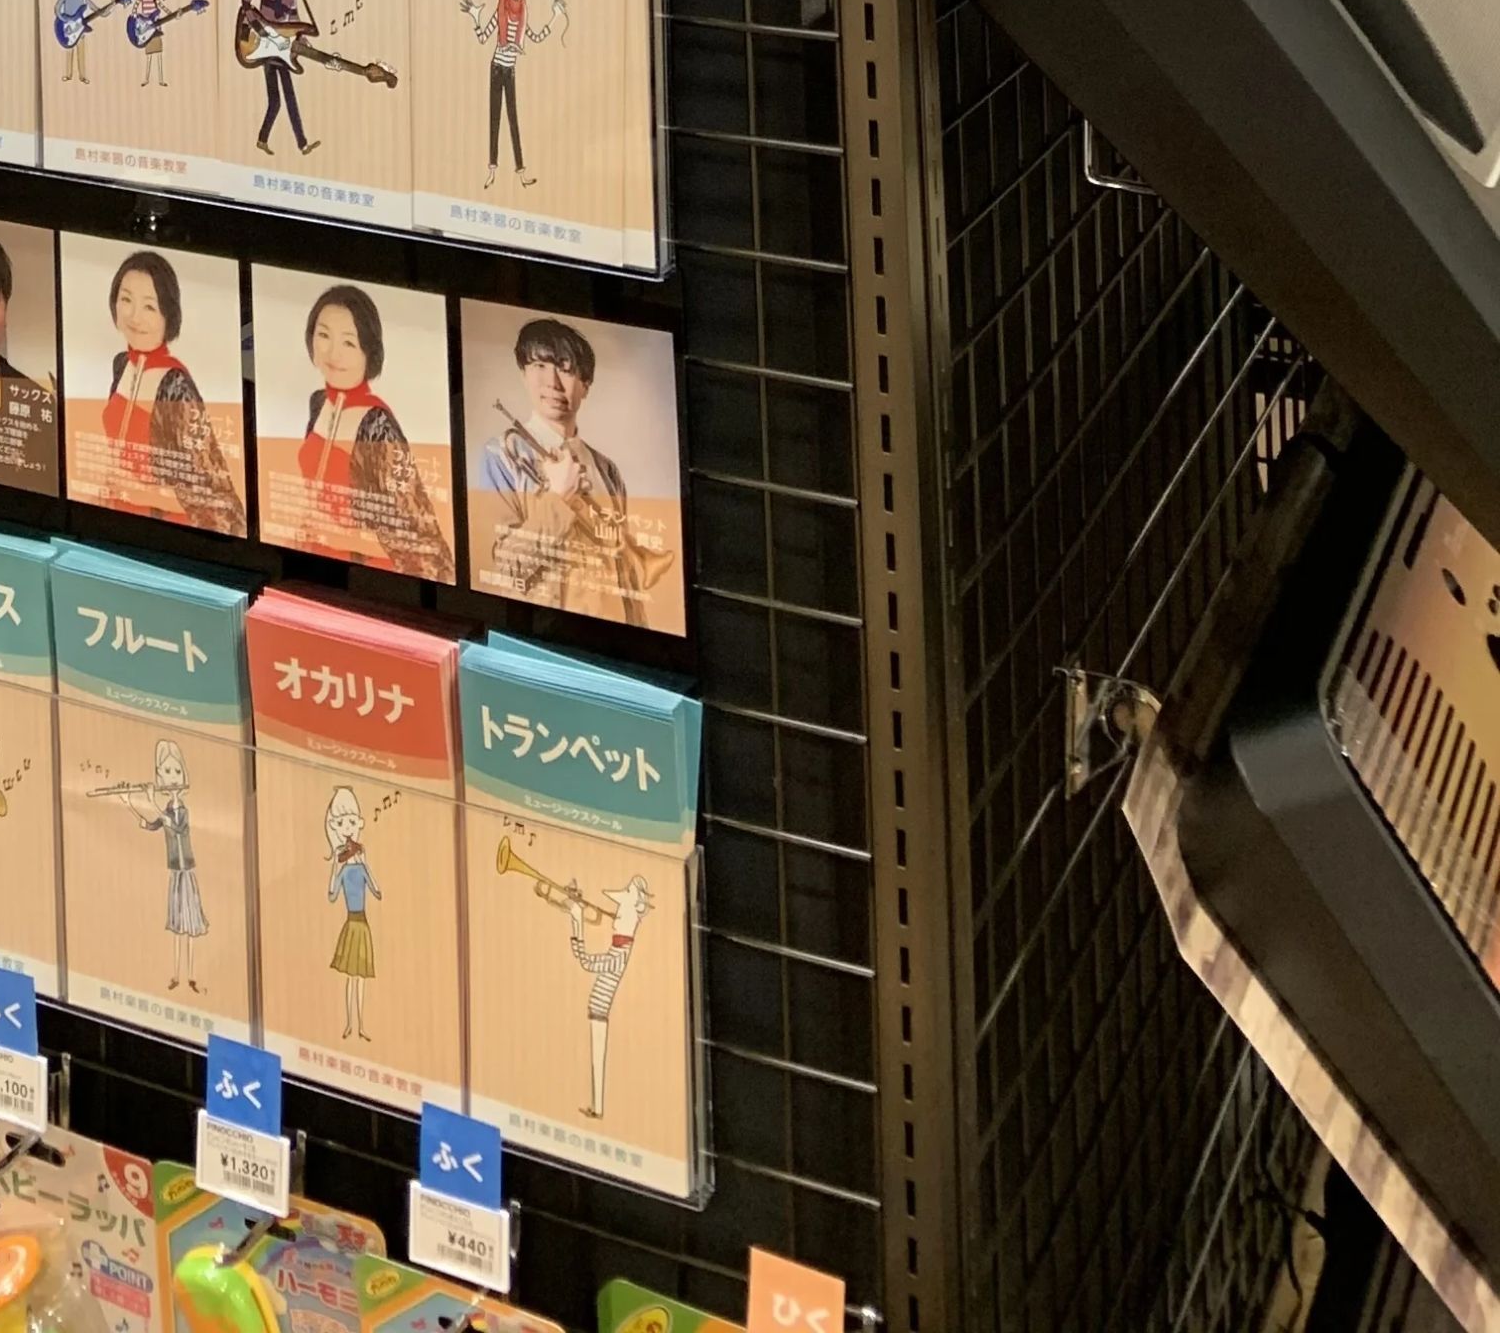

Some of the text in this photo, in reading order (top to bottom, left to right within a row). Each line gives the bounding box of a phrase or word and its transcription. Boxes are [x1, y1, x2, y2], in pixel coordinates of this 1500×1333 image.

[9, 385, 52, 404] サックス
[589, 505, 666, 531] トランペット
[77, 606, 208, 672] フルート
[272, 658, 415, 723] オカリナ
[481, 705, 661, 792] トランペット
[215, 1070, 261, 1109] ふく
[220, 1152, 269, 1181] ¥1,320
[432, 1141, 483, 1183] ふく
[448, 1231, 486, 1257] ¥440
[107, 1257, 150, 1292] POINT
